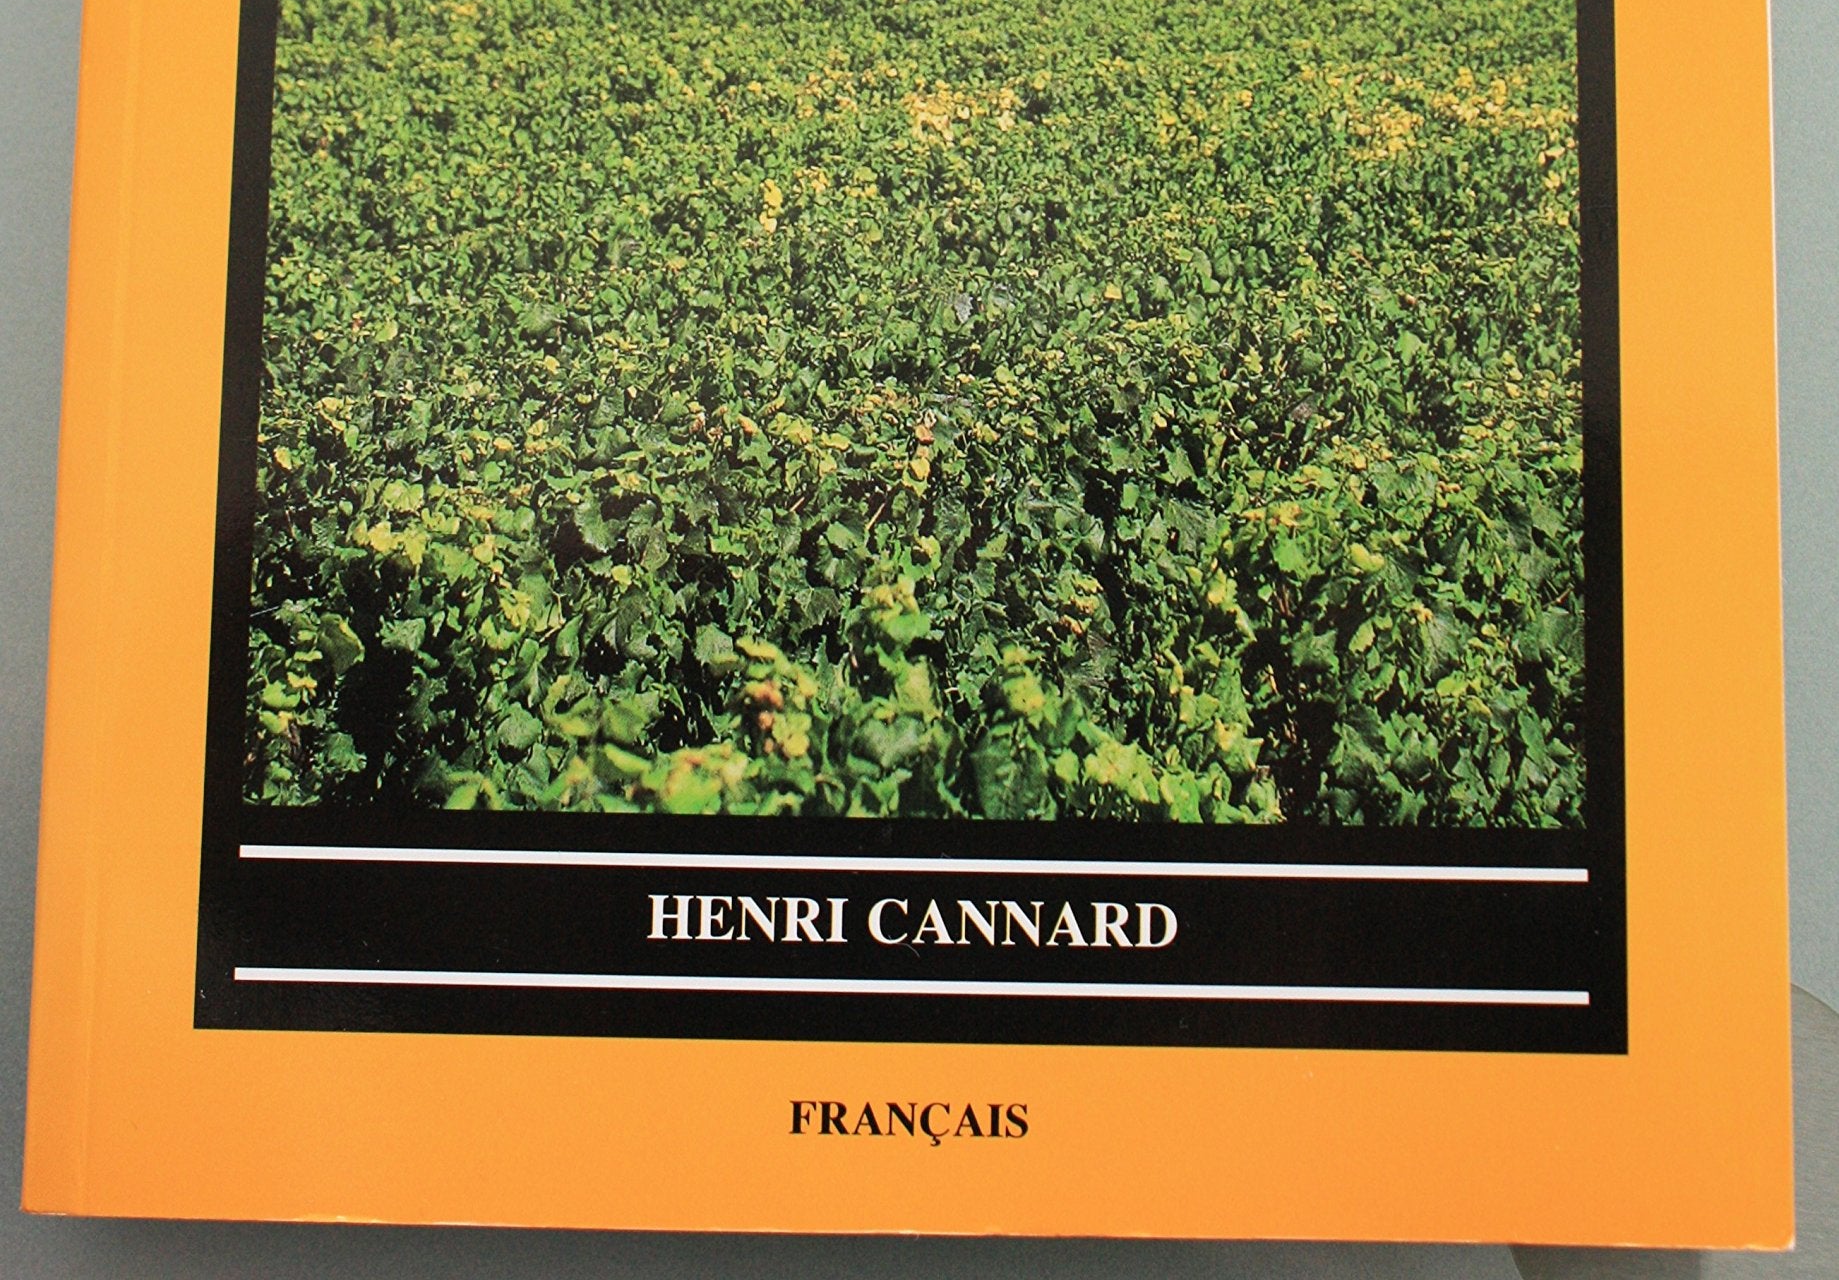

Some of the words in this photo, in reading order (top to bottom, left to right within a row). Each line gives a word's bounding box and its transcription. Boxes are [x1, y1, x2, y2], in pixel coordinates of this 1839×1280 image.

[646, 894, 849, 943] HENRI
[867, 898, 1179, 949] CANNARD
[789, 1100, 1030, 1147] FRANÇAIS
